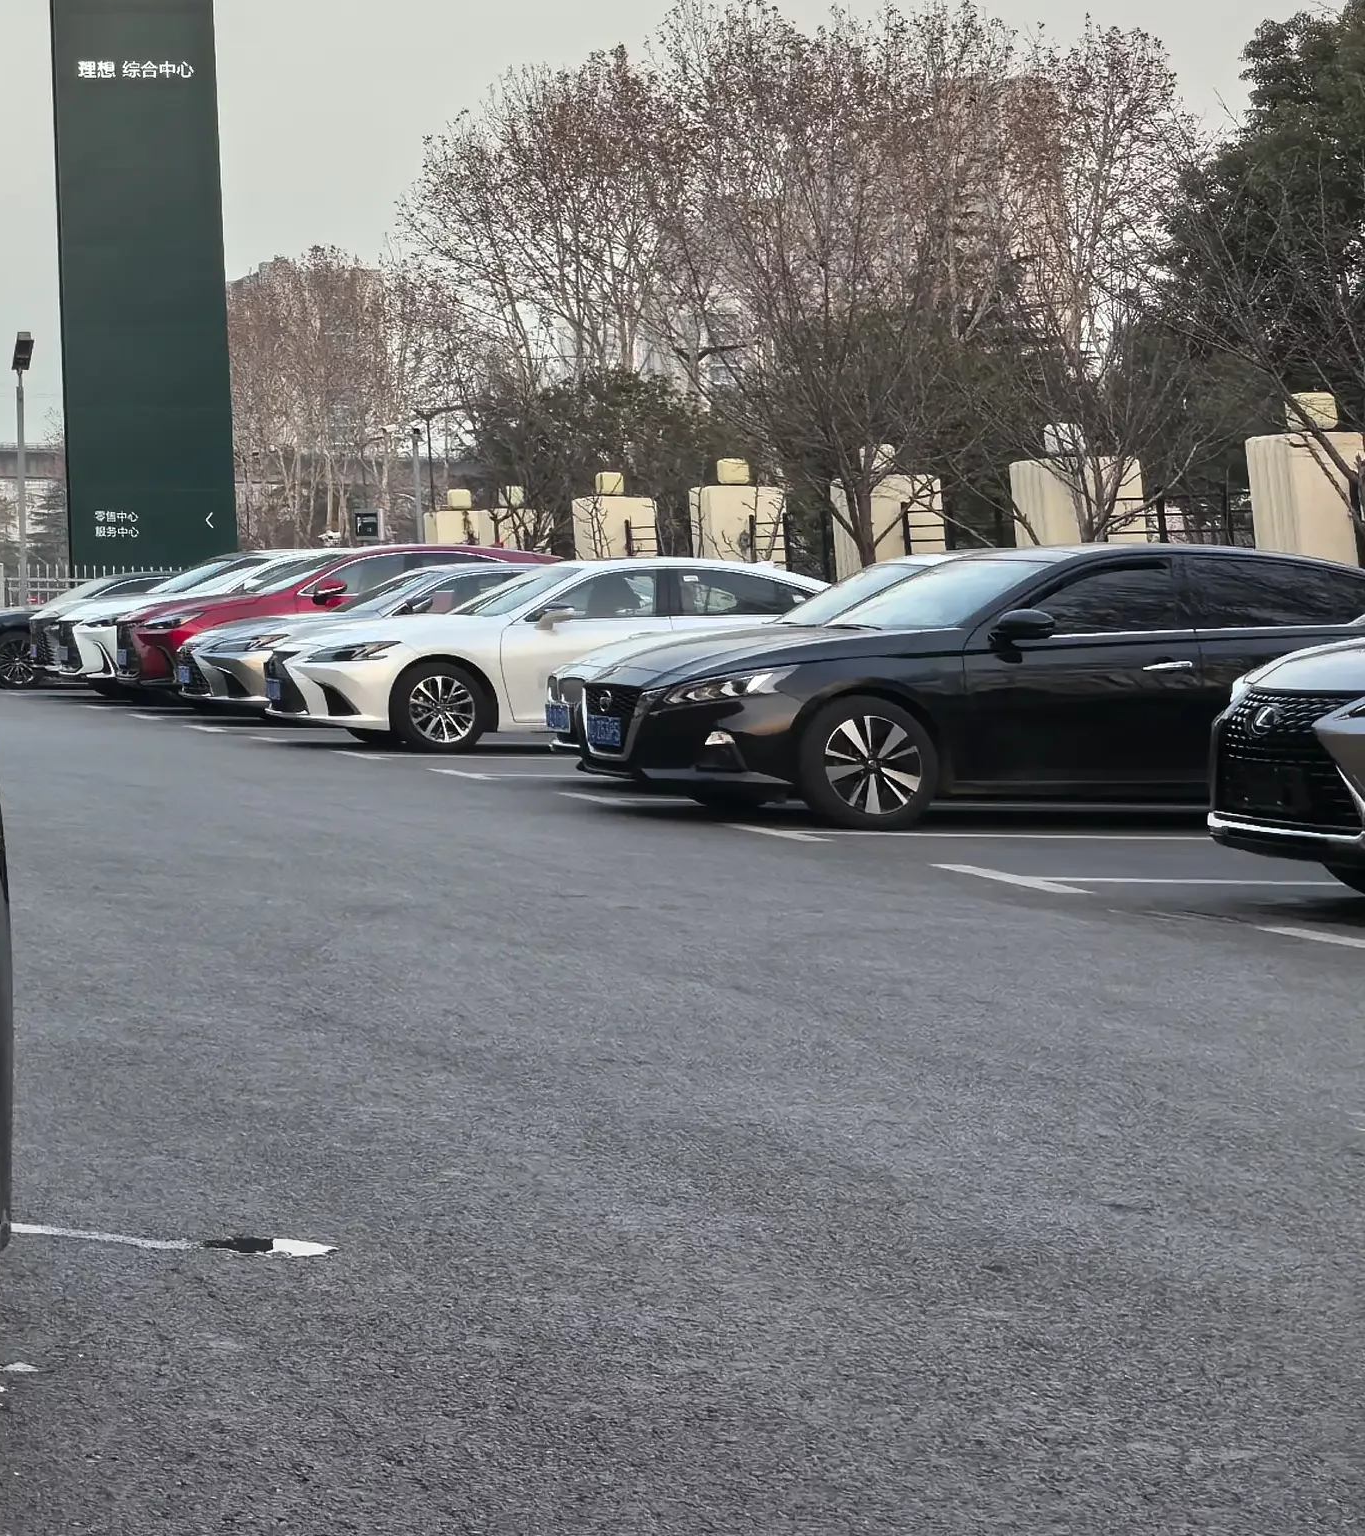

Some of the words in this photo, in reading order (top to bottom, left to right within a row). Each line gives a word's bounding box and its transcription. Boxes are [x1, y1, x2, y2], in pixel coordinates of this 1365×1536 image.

[77, 61, 117, 78] 理想
[122, 61, 195, 78] 综合中心
[94, 510, 139, 523] 零售中心
[95, 526, 140, 538] 服务中心
